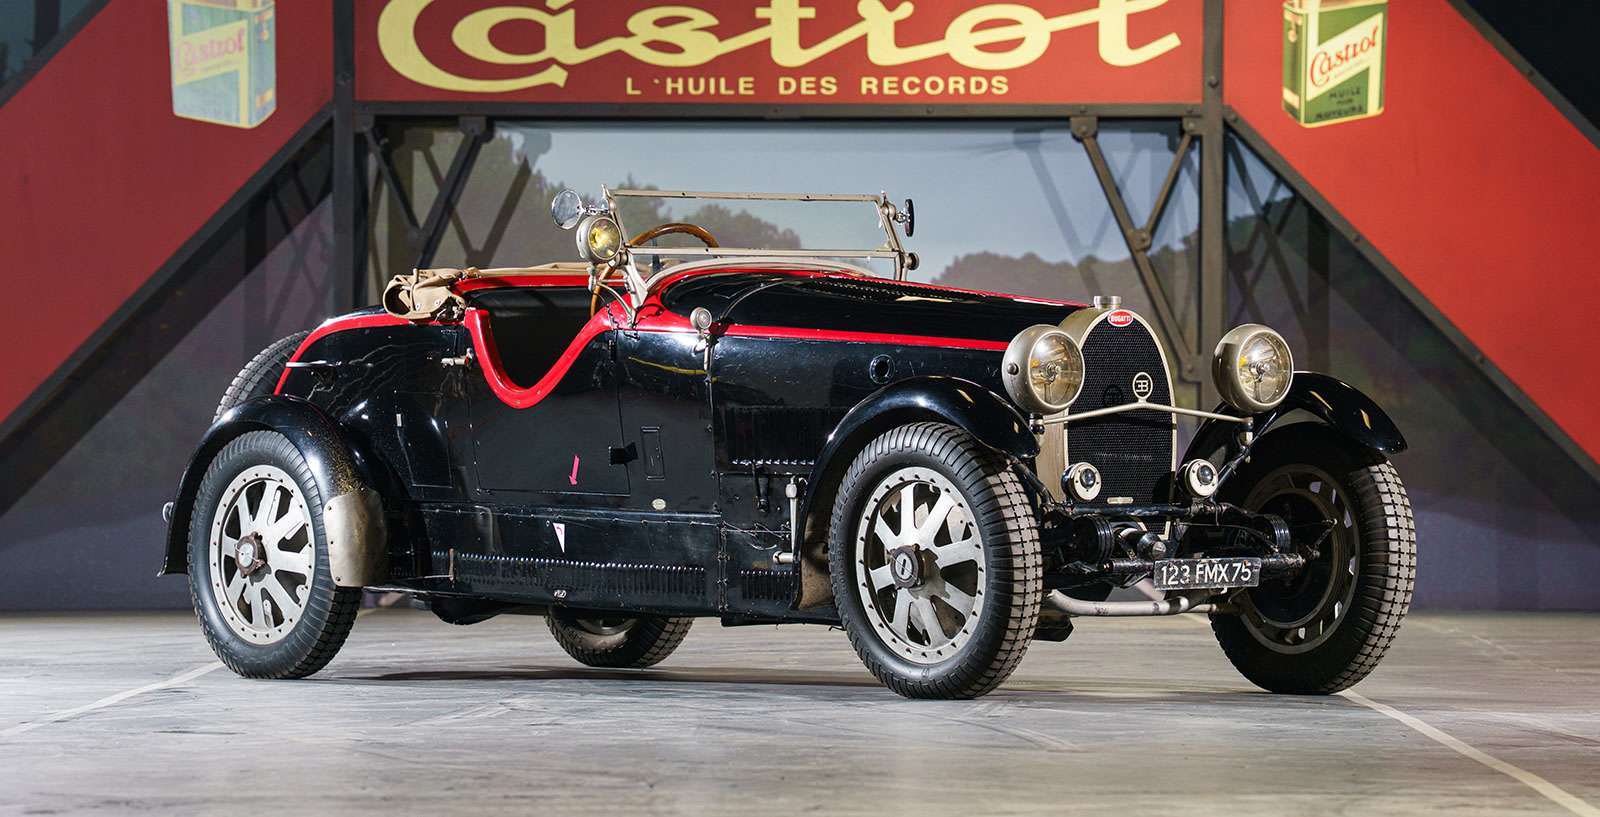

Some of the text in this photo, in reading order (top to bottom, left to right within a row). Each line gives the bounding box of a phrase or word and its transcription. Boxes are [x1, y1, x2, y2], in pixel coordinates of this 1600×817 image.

[1310, 25, 1379, 88] Castrol
[778, 76, 838, 95] DES
[860, 76, 1009, 95] RECORDS
[1161, 561, 1252, 585] 123 FMX 75
